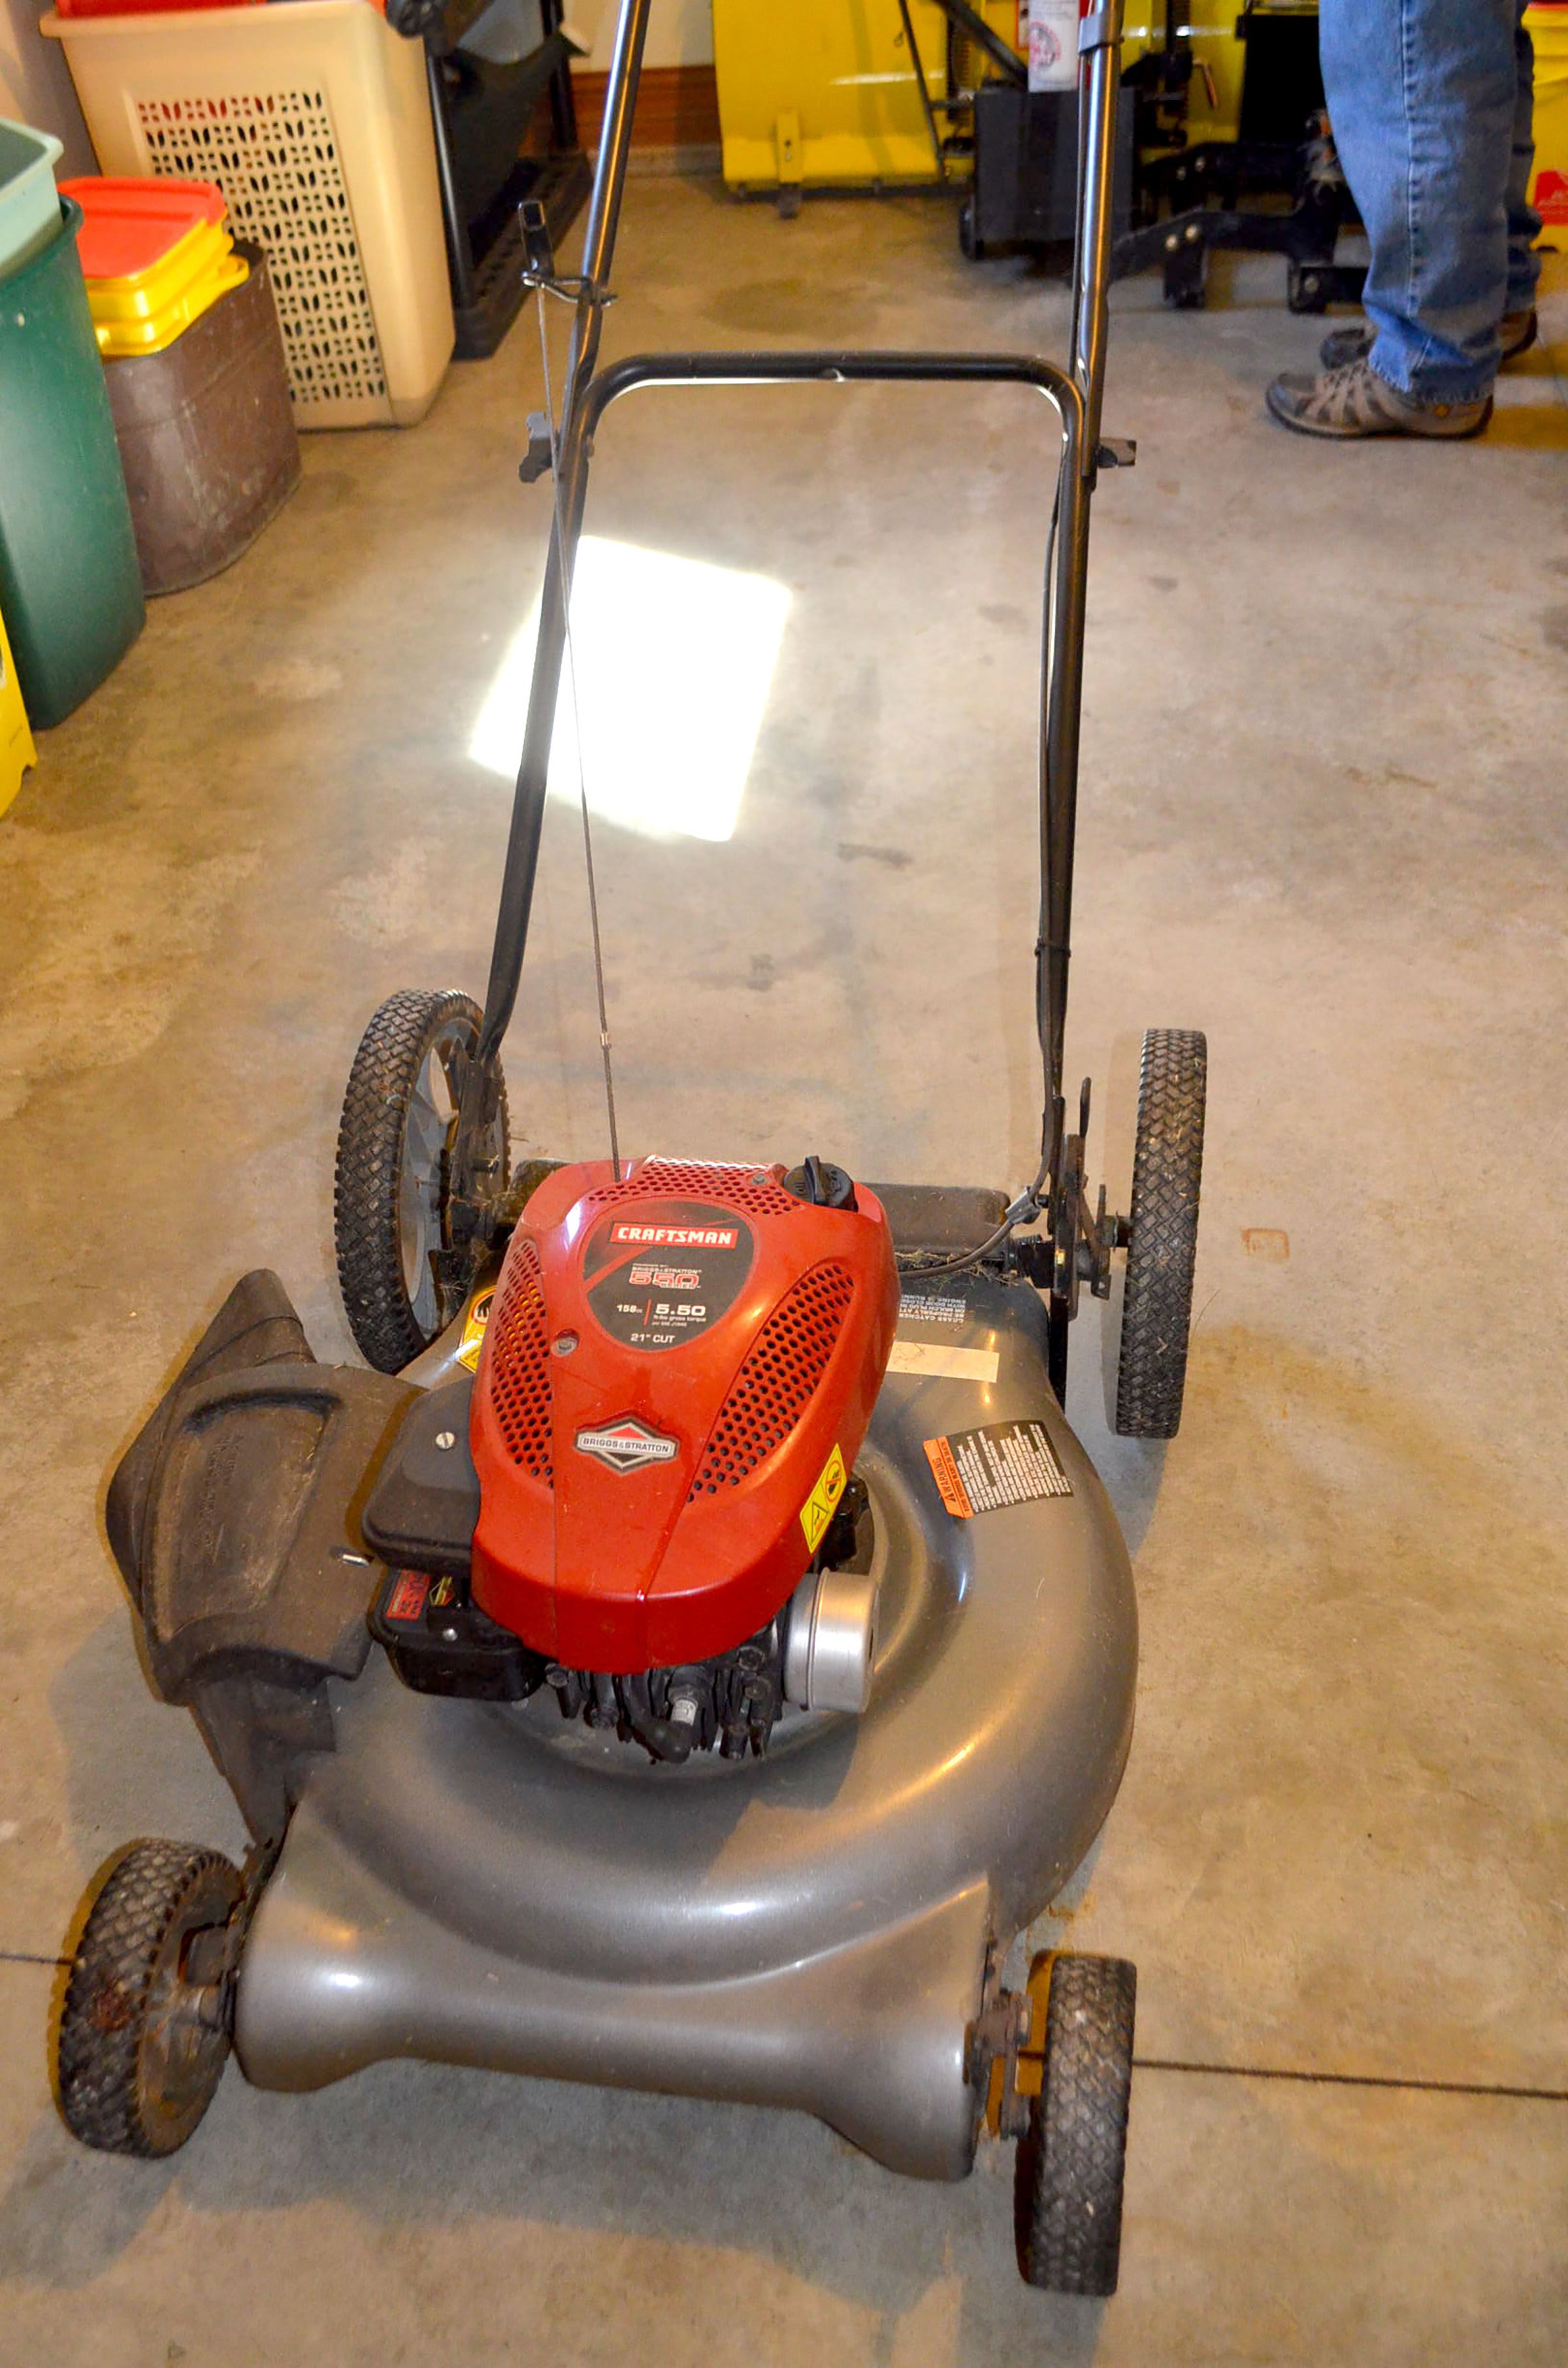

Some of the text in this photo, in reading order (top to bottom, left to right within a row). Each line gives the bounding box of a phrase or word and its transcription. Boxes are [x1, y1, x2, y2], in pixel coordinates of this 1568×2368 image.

[617, 1227, 732, 1244] CRAFTSMAN
[629, 1272, 699, 1288] 550
[655, 1304, 706, 1317] 5.50
[653, 1334, 676, 1343] CUT
[932, 1457, 951, 1493] WARNING
